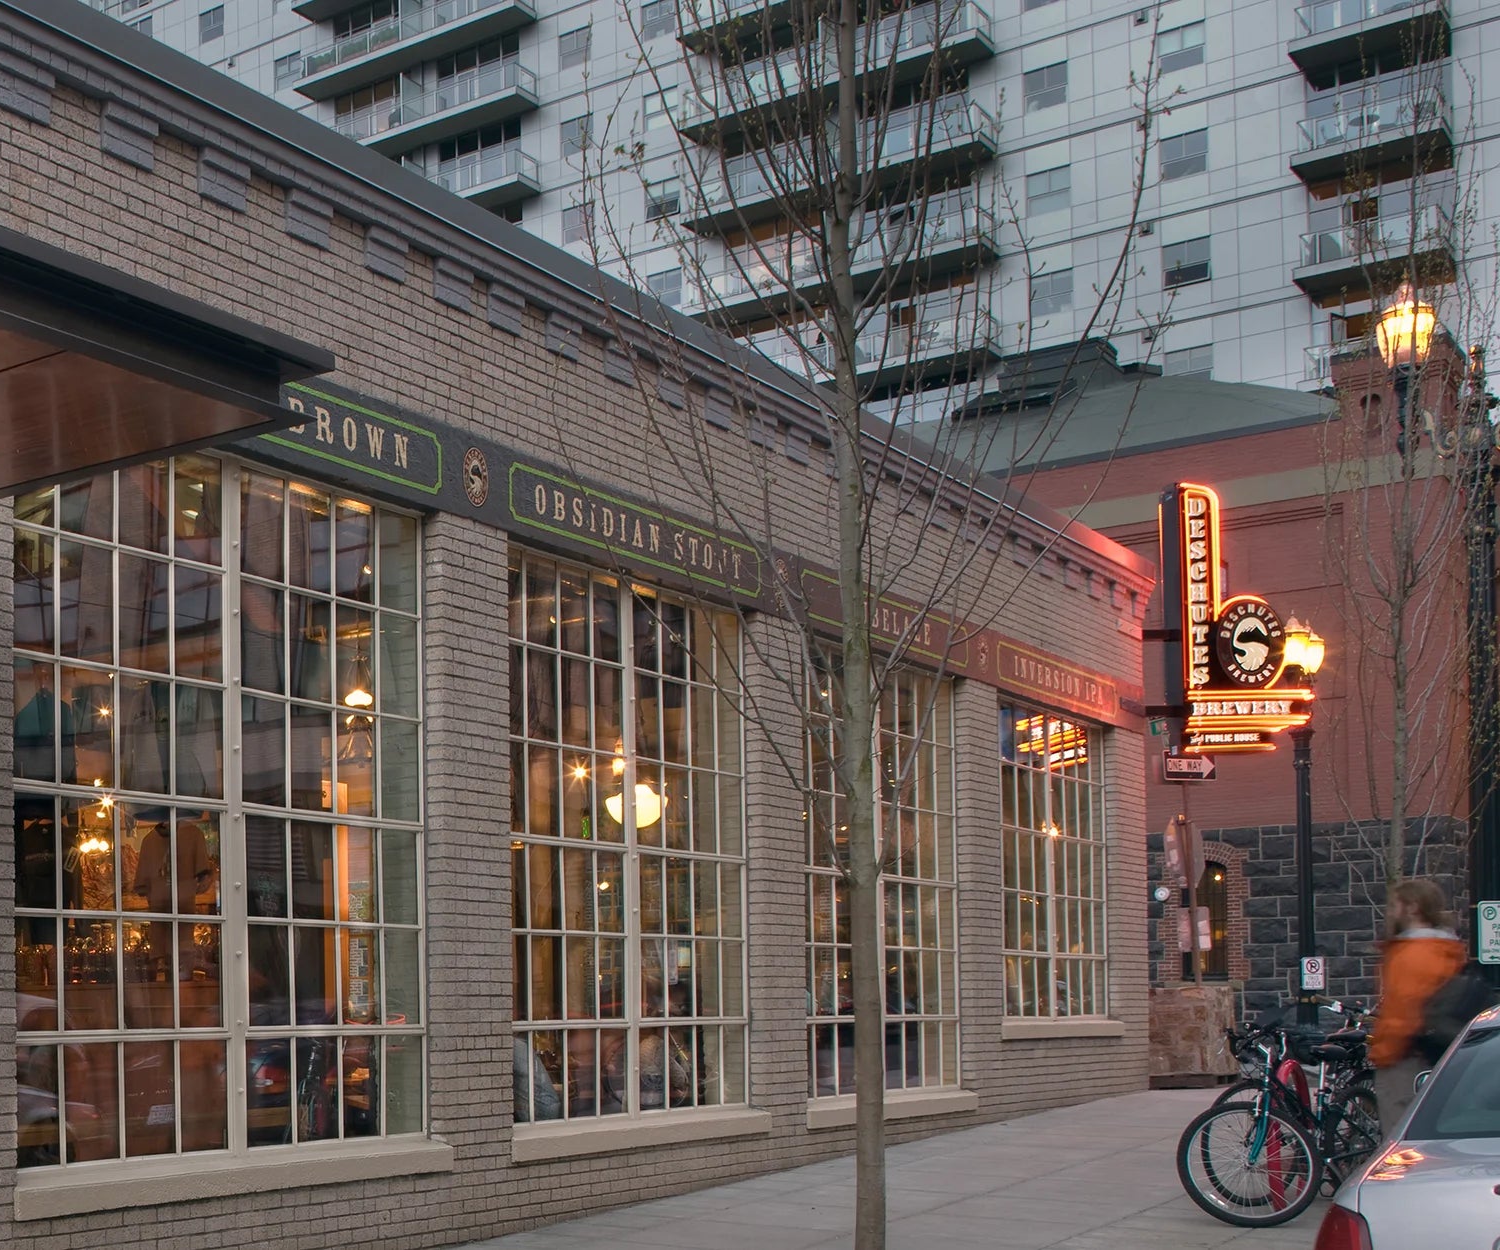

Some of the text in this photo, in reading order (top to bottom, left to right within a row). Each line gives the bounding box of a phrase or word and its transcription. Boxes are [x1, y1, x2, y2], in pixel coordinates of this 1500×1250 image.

[287, 396, 409, 470] BROWN
[535, 484, 660, 554] OBSIDIAN
[1188, 498, 1210, 686] DESCHUTES
[1219, 603, 1282, 639] DESCHUTES
[1014, 655, 1103, 705] INVERSION IPA
[1227, 662, 1276, 684] BREWERY
[1191, 700, 1293, 717] BREWERY
[1205, 733, 1233, 743] PUBLIC
[1233, 732, 1260, 742] HOUSE
[1167, 759, 1202, 771] ONE WAY
